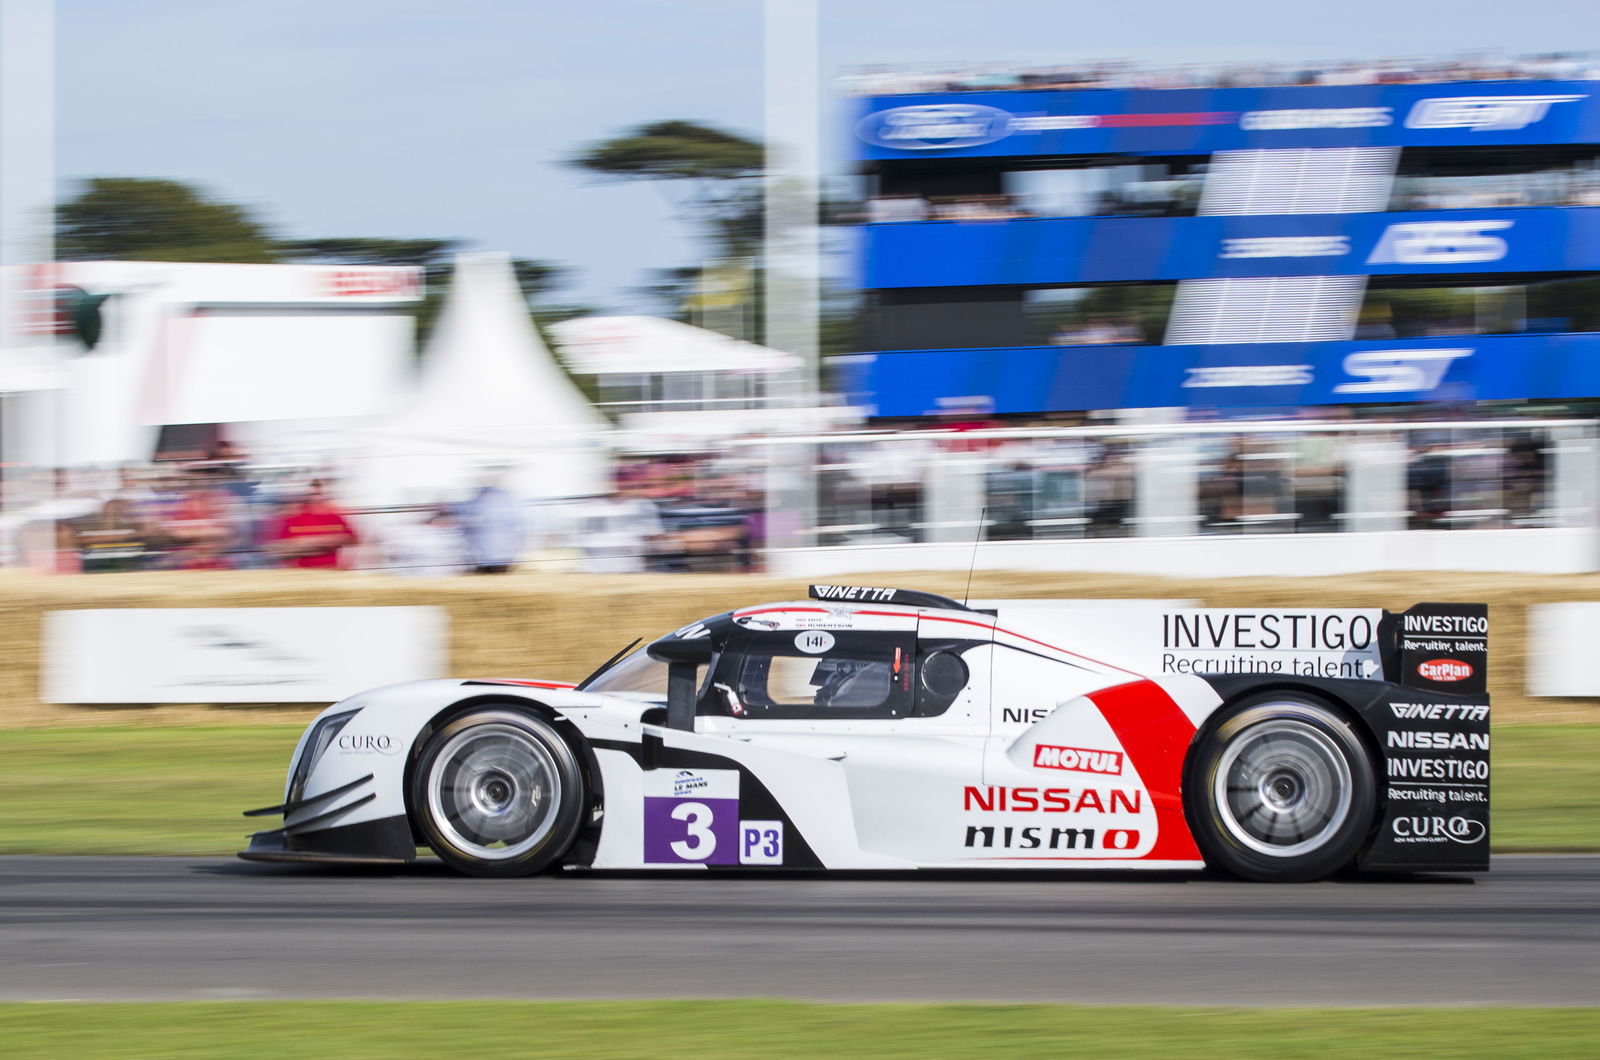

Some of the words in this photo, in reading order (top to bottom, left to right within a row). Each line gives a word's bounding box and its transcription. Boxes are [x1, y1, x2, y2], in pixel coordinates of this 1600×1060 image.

[814, 585, 897, 601] GINETTA
[1162, 614, 1373, 650] INVESTIGO
[1404, 615, 1488, 633] INVESTIGO
[1292, 655, 1371, 678] talent.
[1420, 663, 1470, 677] CarPlan
[1389, 703, 1490, 720] GINETTA
[1387, 731, 1490, 750] NISSAN
[1036, 747, 1120, 773] MOTUL
[1387, 758, 1489, 779] INVESTIGO
[964, 786, 1141, 814] NISSAN
[1387, 788, 1446, 803] Recruiting
[1448, 790, 1488, 802] talent.
[670, 802, 717, 860] 3
[1392, 816, 1484, 842] CURO
[745, 829, 779, 857] P3
